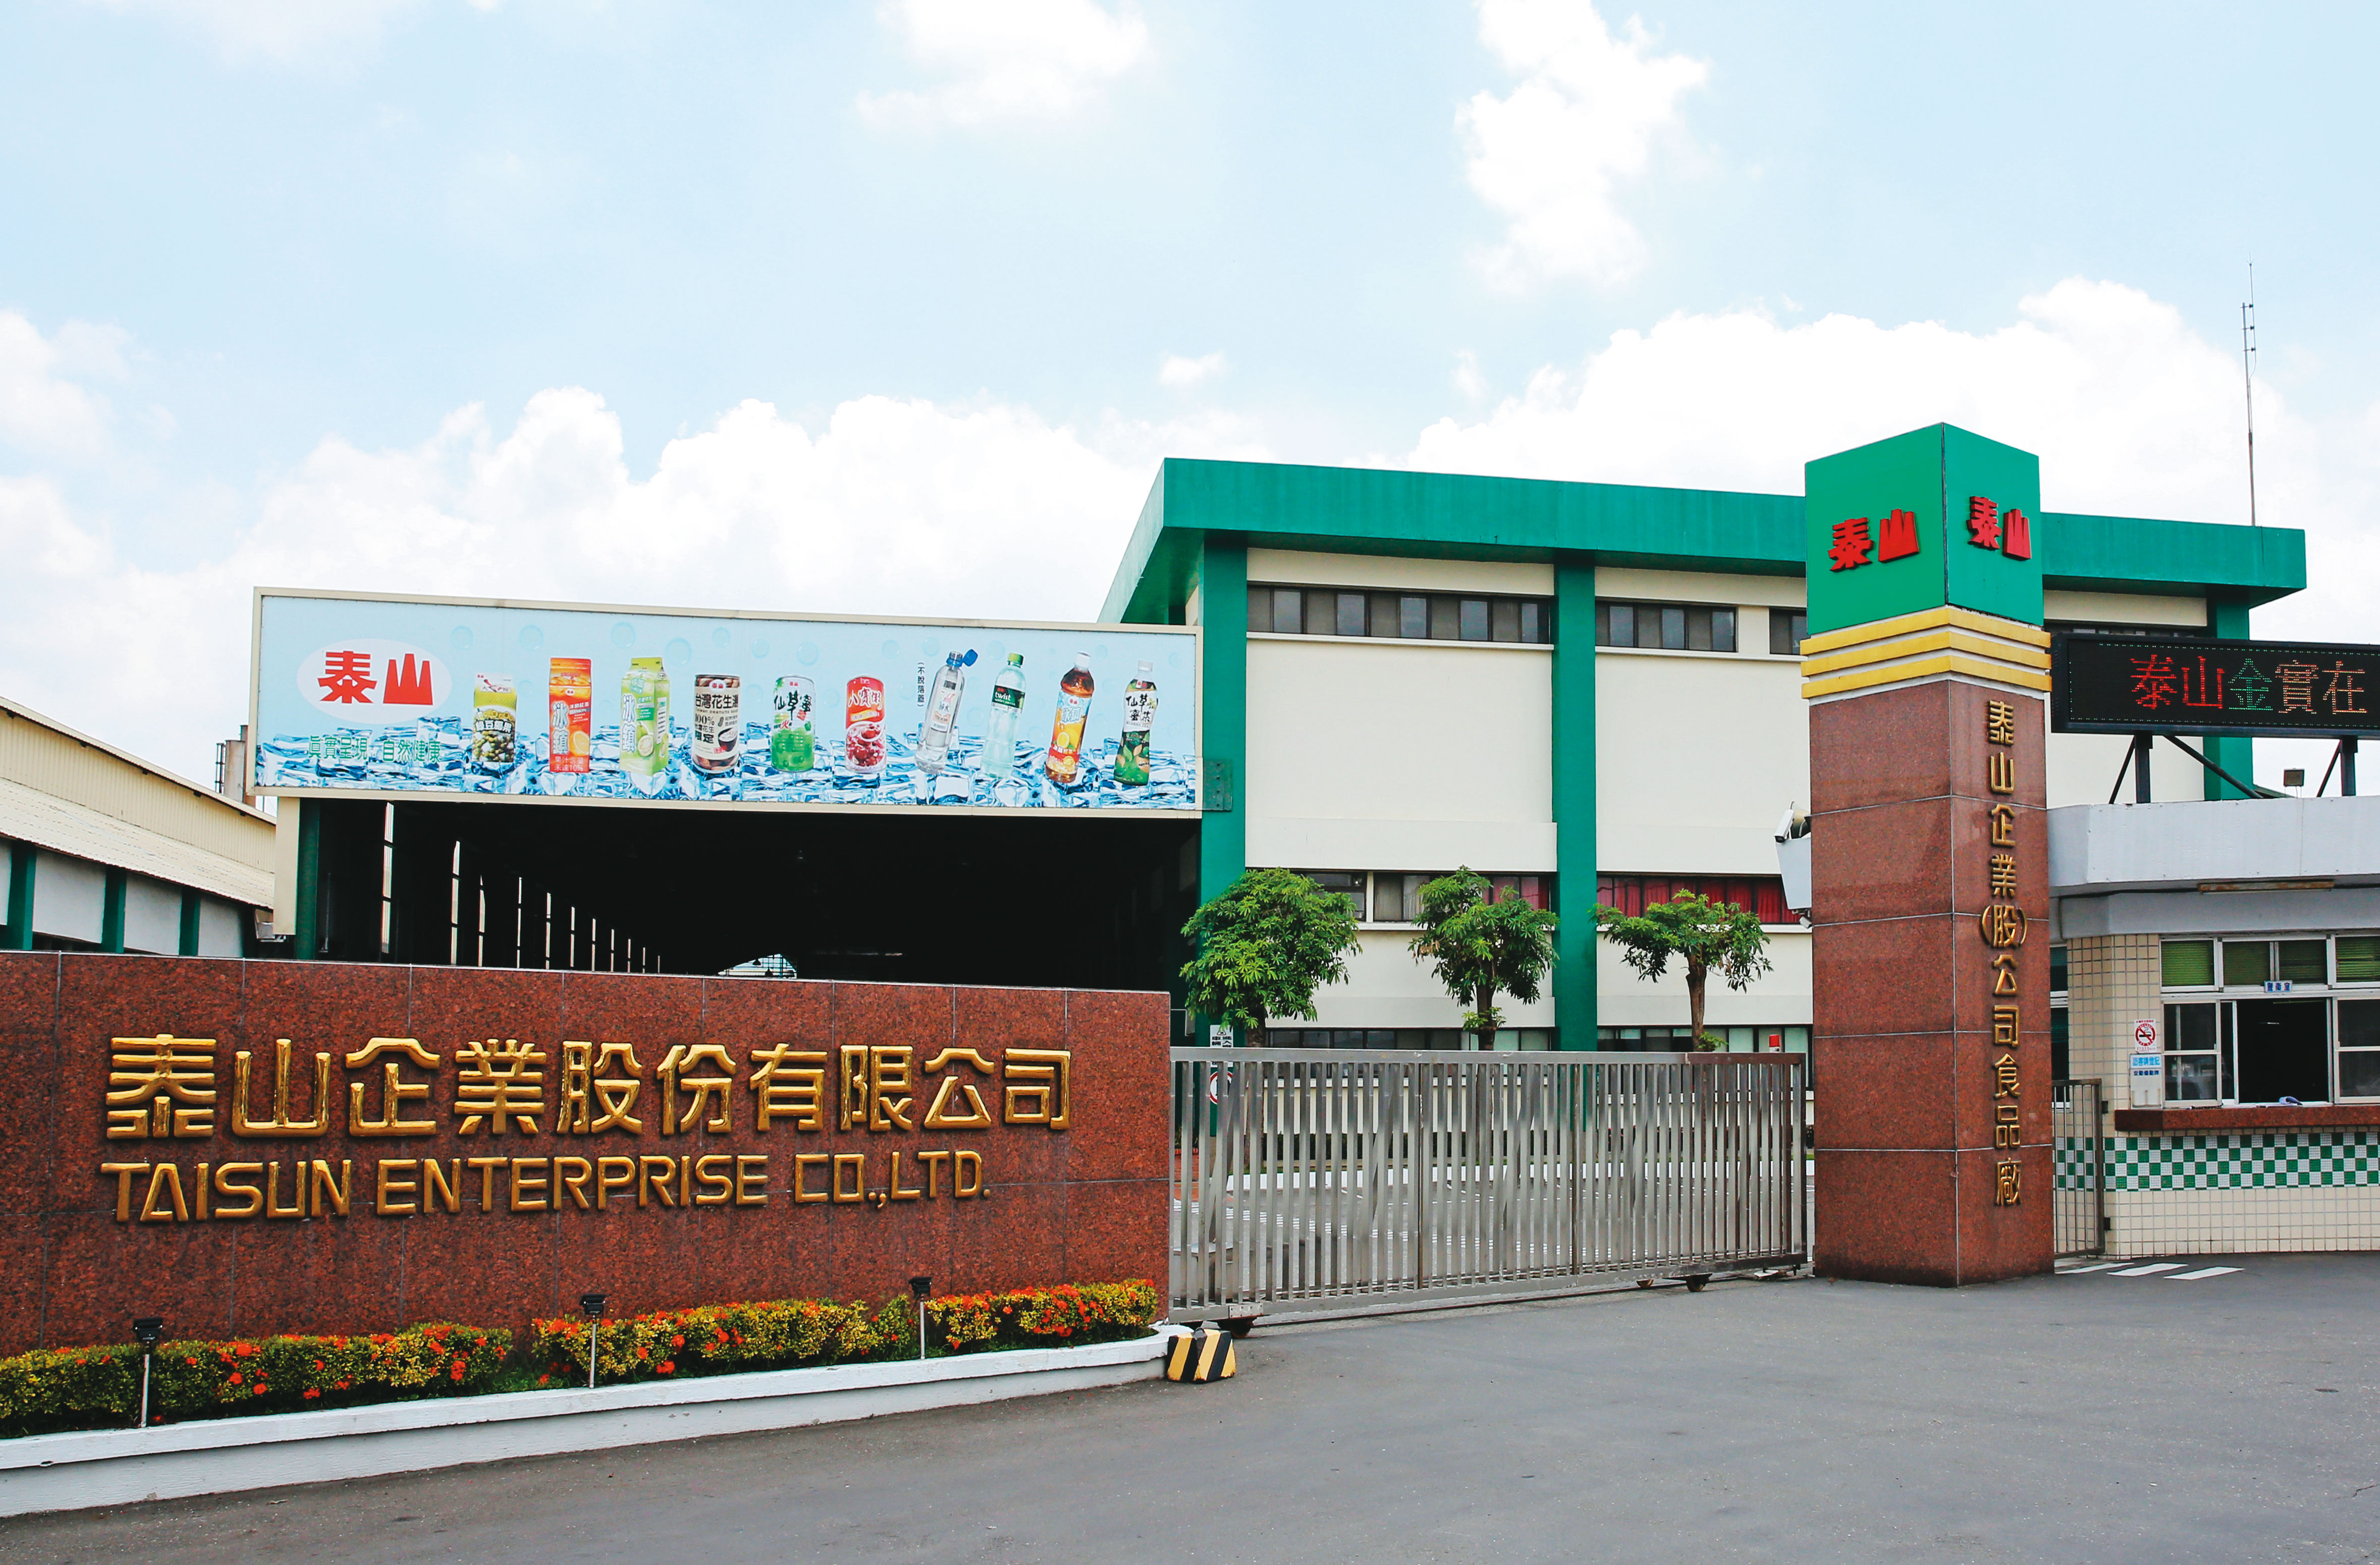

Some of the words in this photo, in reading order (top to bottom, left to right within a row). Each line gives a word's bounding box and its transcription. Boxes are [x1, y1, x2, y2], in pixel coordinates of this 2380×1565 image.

[1828, 509, 1919, 572] 泰山
[1967, 496, 2031, 561] 泰山
[317, 651, 433, 705] 泰山
[995, 692, 1011, 701] twist
[2131, 654, 2367, 715] 泰山金實在
[695, 713, 715, 725] 100%
[383, 739, 441, 763] 自然健康
[106, 1034, 1071, 1139] 泰山企業股份有限公司
[101, 1159, 352, 1222] TAISUN
[377, 1154, 769, 1215] ENTERPRISE
